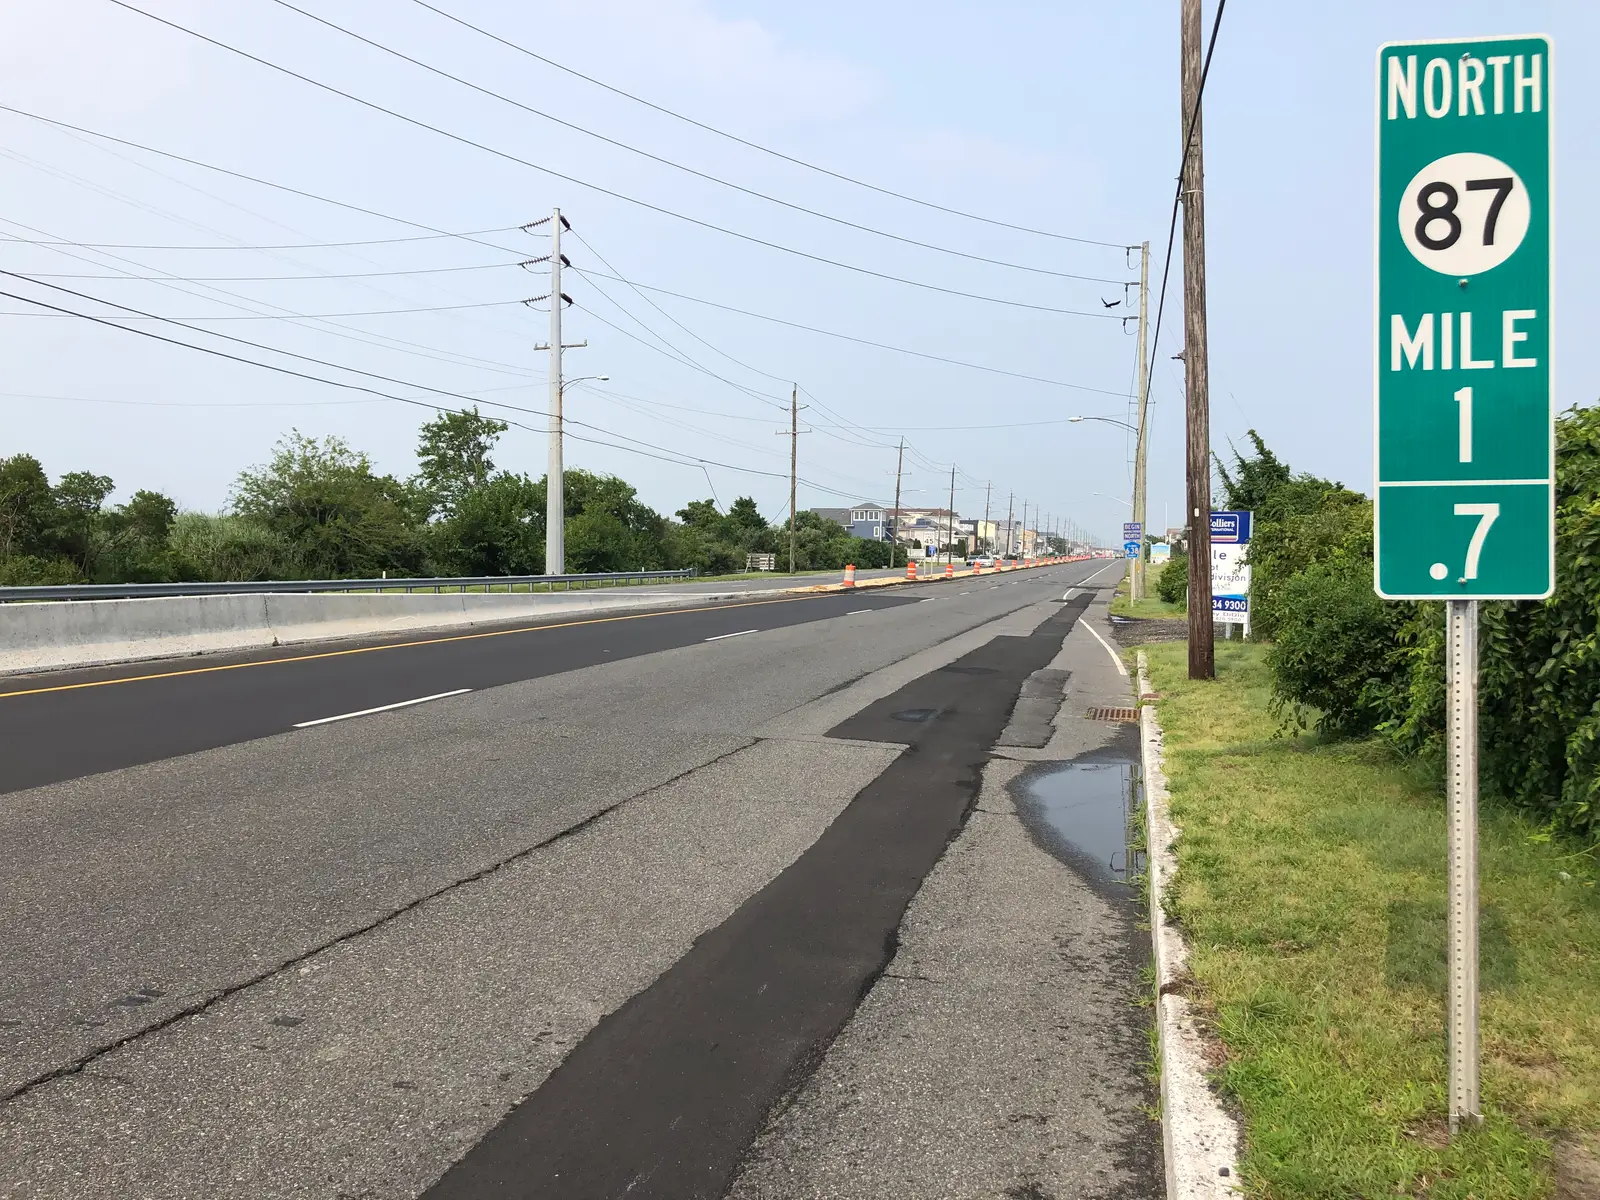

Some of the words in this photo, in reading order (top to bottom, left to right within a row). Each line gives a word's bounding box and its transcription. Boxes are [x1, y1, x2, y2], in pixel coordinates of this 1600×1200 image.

[1387, 54, 1542, 120] NORTH
[1415, 177, 1513, 250] 87
[1391, 309, 1537, 371] MILE
[1454, 387, 1472, 462] 1
[1210, 518, 1235, 528] olliers
[1429, 503, 1499, 579] .7
[1224, 600, 1246, 610] 9300
